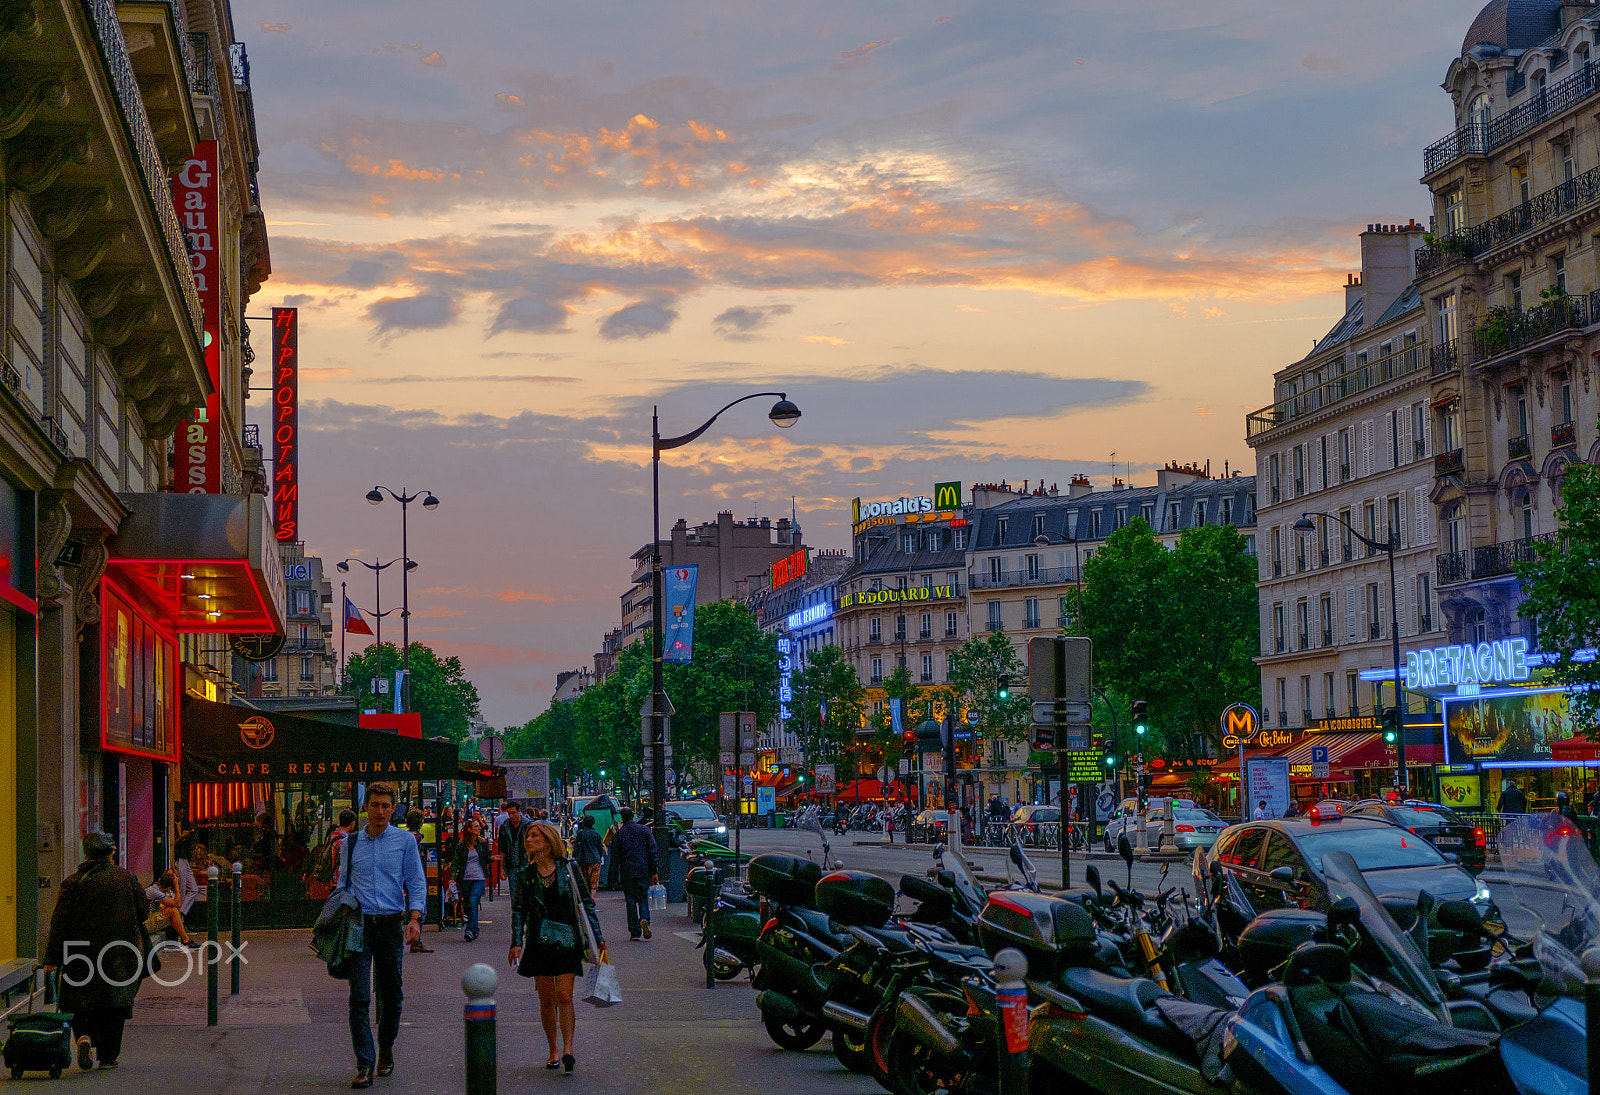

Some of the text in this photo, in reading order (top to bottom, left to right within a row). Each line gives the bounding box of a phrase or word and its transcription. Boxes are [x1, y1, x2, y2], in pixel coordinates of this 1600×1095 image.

[178, 159, 213, 304] Gaumon
[274, 310, 297, 539] HIPPOPOTAMUS
[282, 561, 312, 580] uel
[858, 587, 930, 604] EDOUARD
[1406, 638, 1528, 689] BRETAGNE
[1228, 710, 1252, 734] M
[1315, 749, 1324, 761] P
[218, 761, 427, 775] CAFE RESTAURANT
